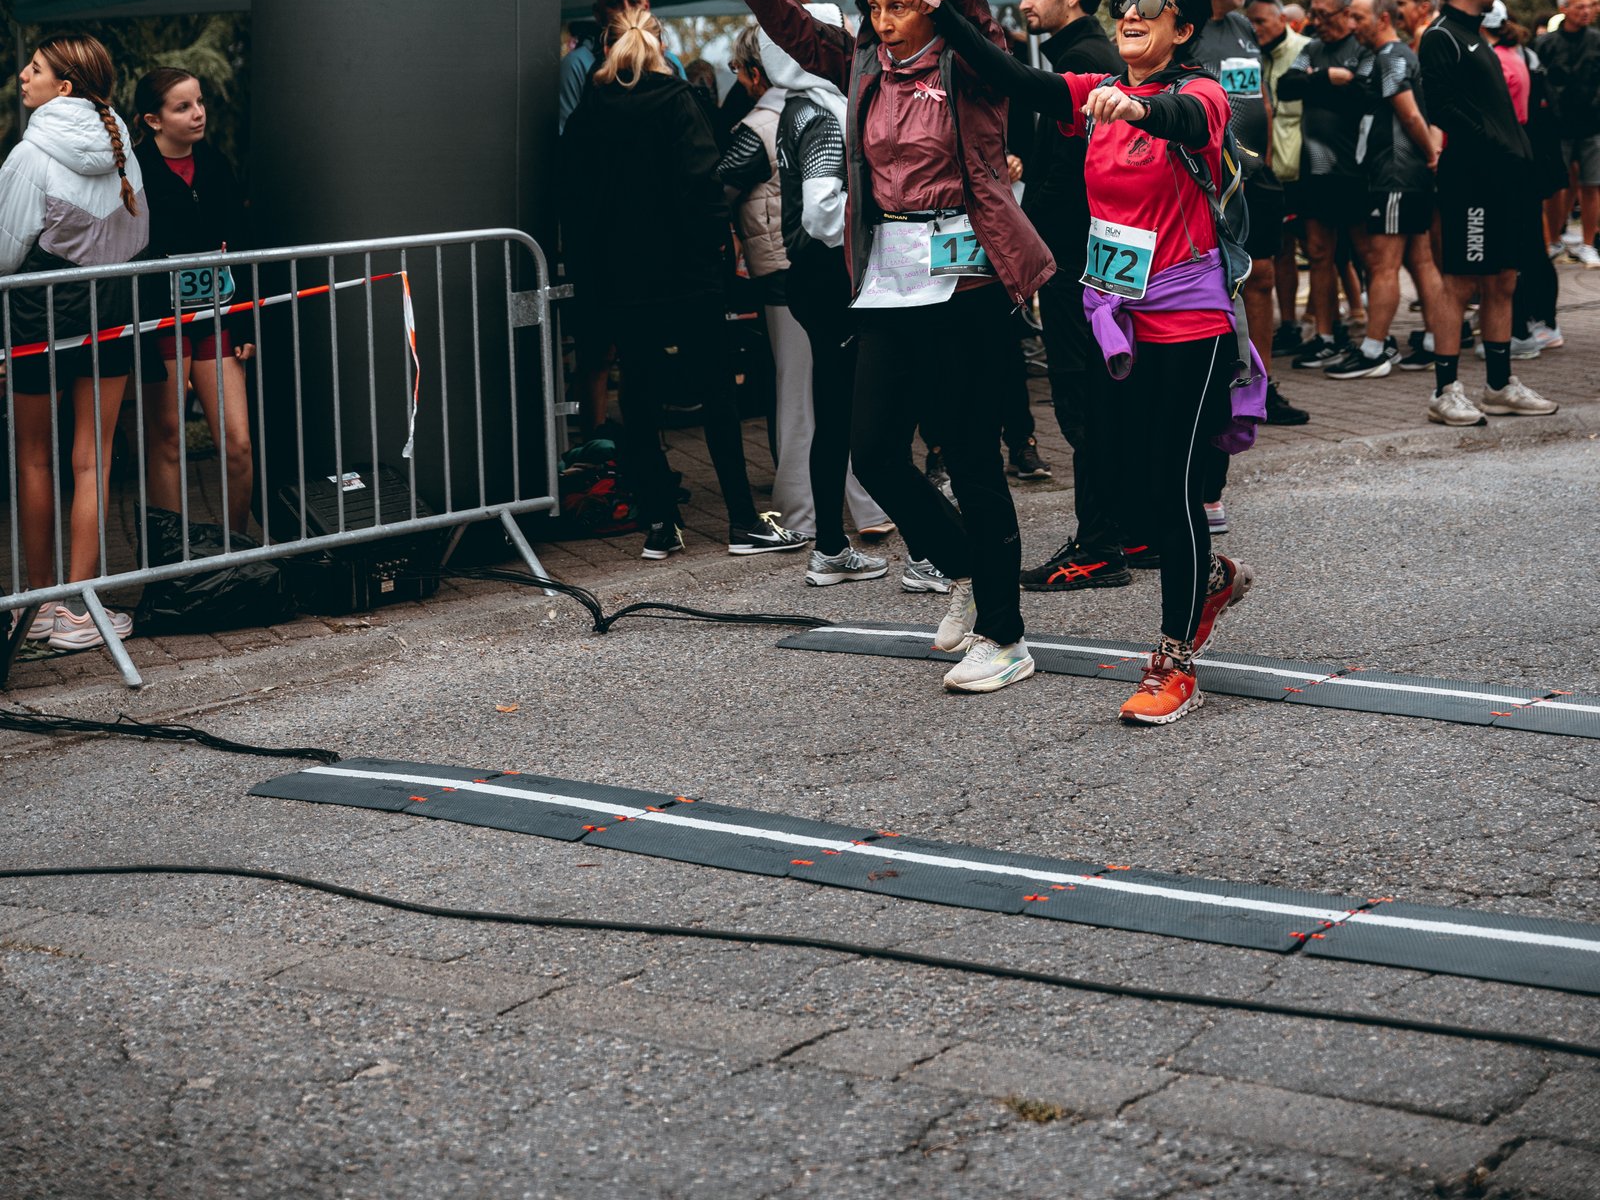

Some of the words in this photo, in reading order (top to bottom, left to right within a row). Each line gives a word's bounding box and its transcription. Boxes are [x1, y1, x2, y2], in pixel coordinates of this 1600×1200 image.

[1226, 71, 1257, 90] 124
[1466, 207, 1485, 262] SHARKS
[1093, 242, 1139, 284] 172
